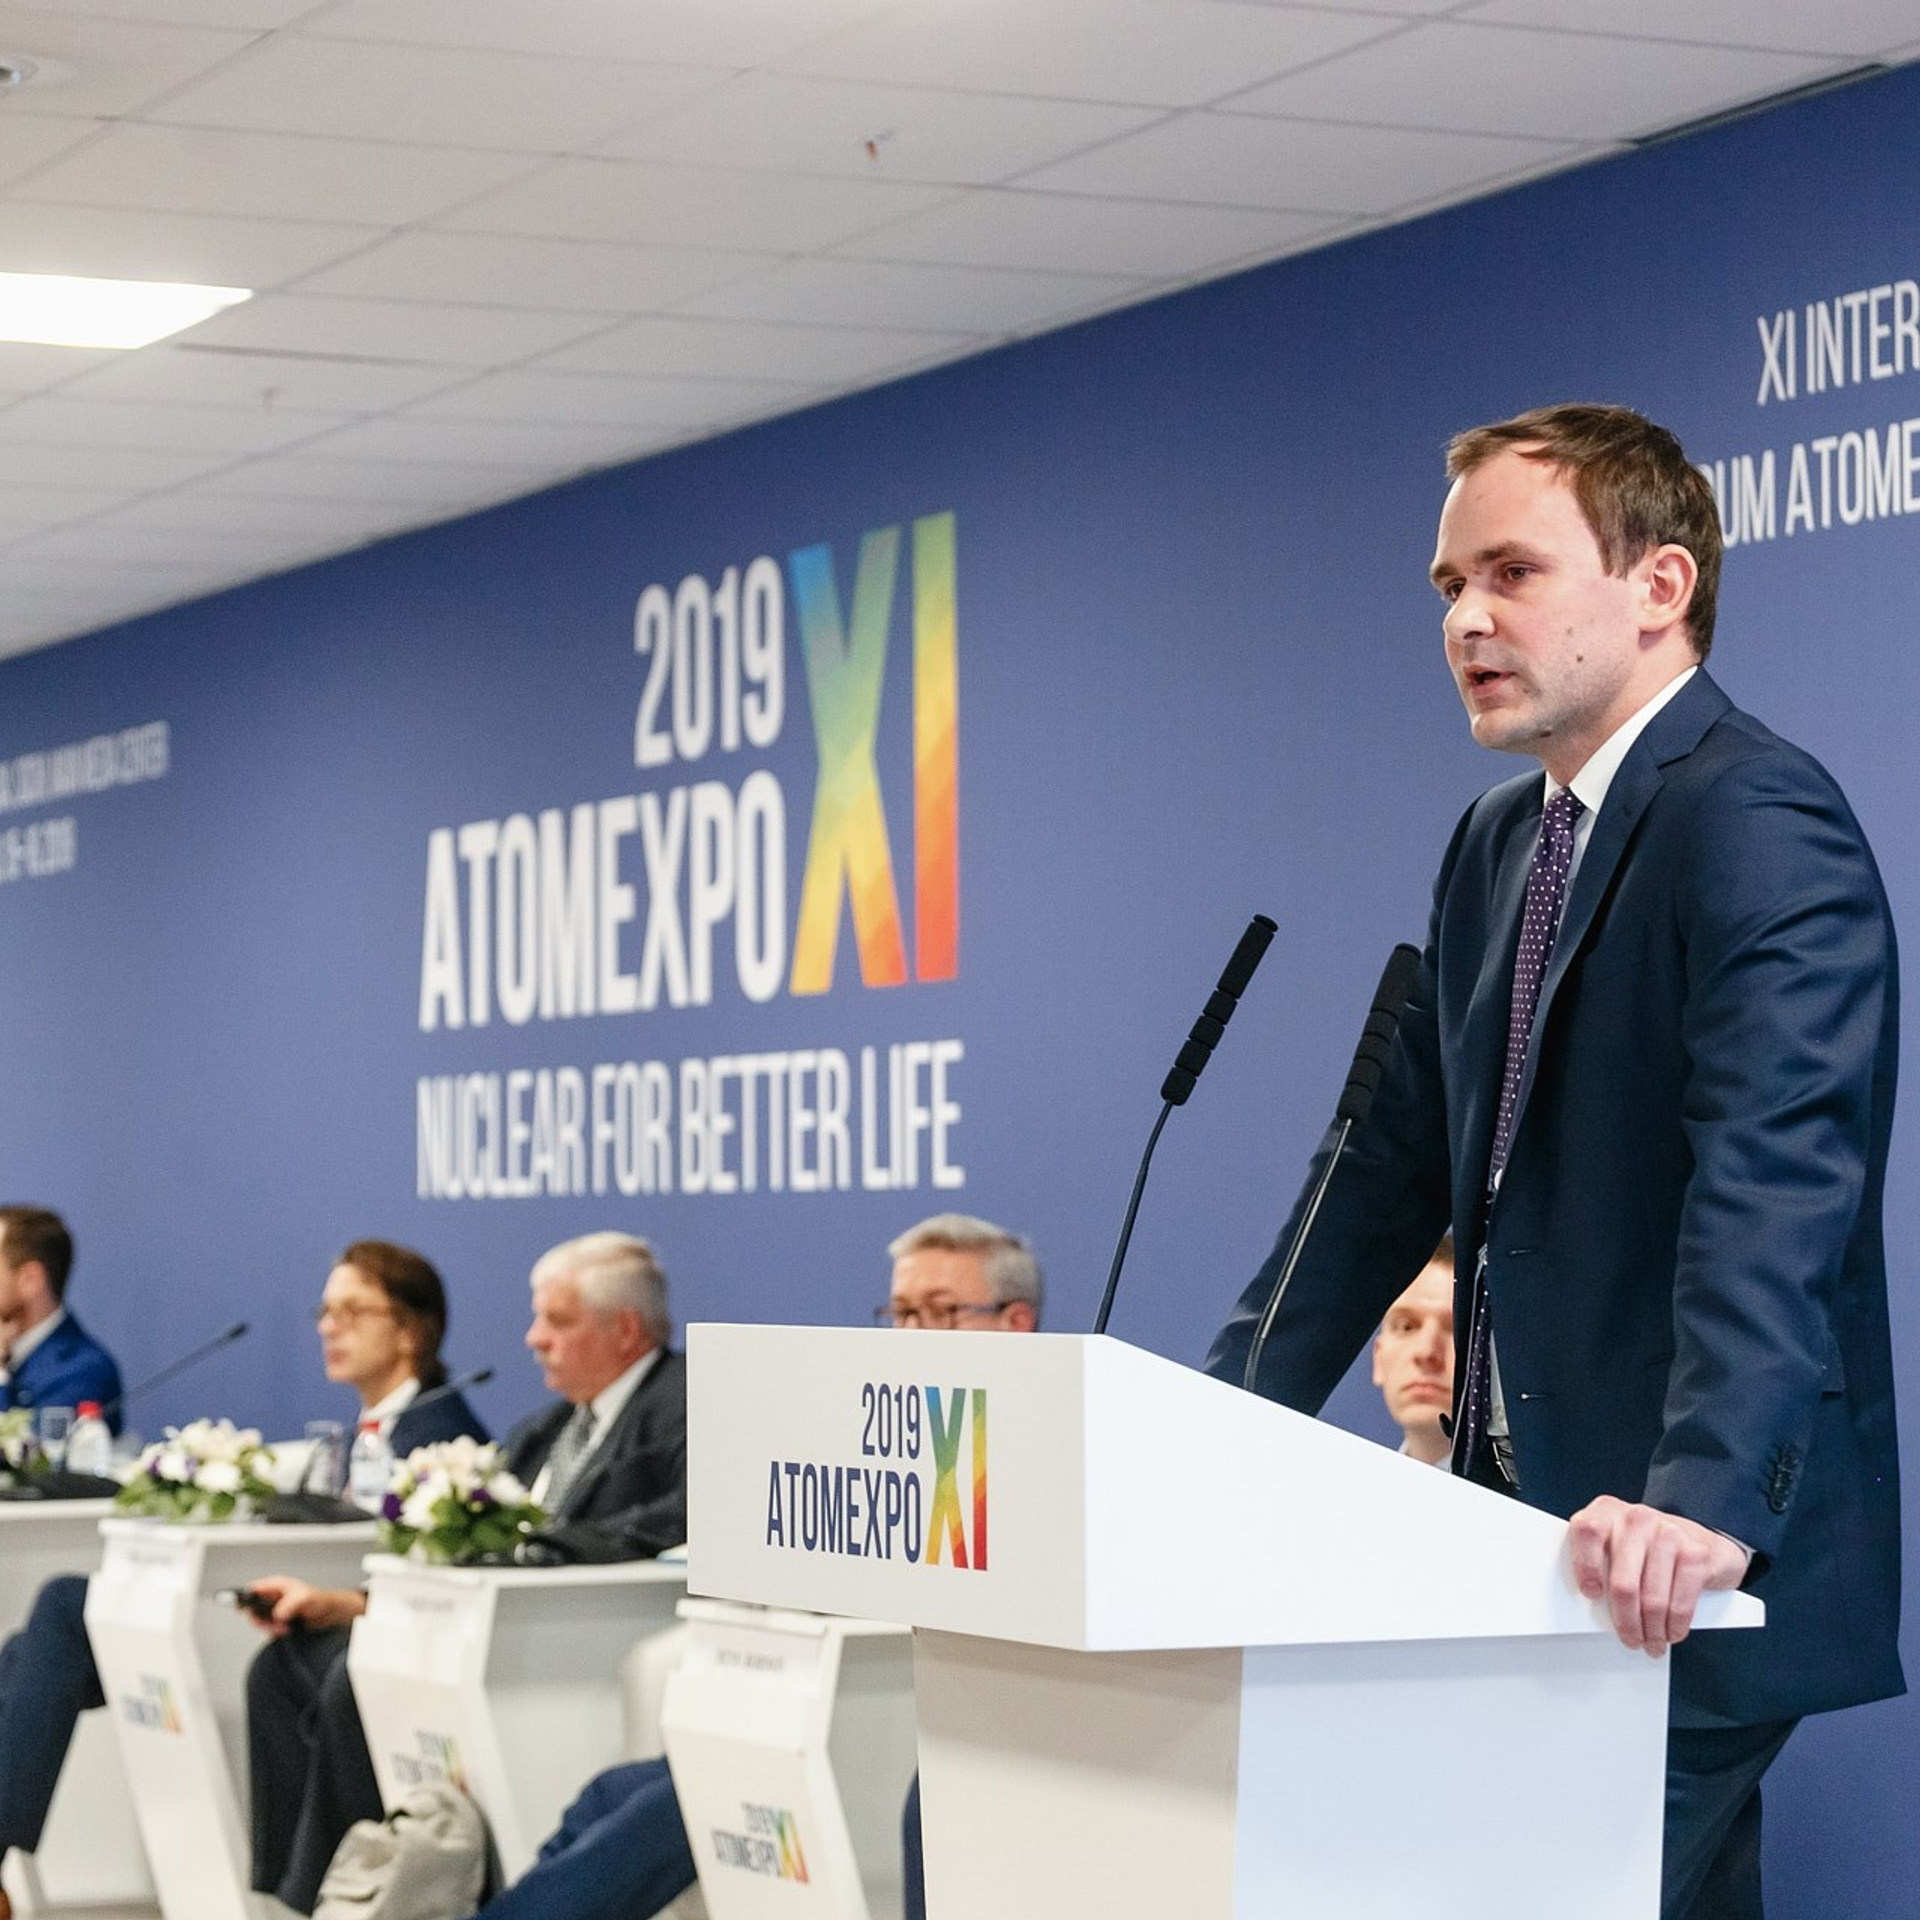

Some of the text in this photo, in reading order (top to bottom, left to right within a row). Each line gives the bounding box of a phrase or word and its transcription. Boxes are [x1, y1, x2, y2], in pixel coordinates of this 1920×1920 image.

[1757, 309, 1796, 406] XI
[1698, 449, 1776, 548] UM
[633, 555, 785, 768] 2019
[790, 511, 958, 995] XI
[418, 770, 787, 1031] ATOMEXPO
[417, 1039, 964, 1199] NUCLEAR FOR BETTER LIFE
[862, 1382, 921, 1460] 2019
[924, 1386, 987, 1571] XI
[766, 1460, 922, 1564] ATOMEXPO
